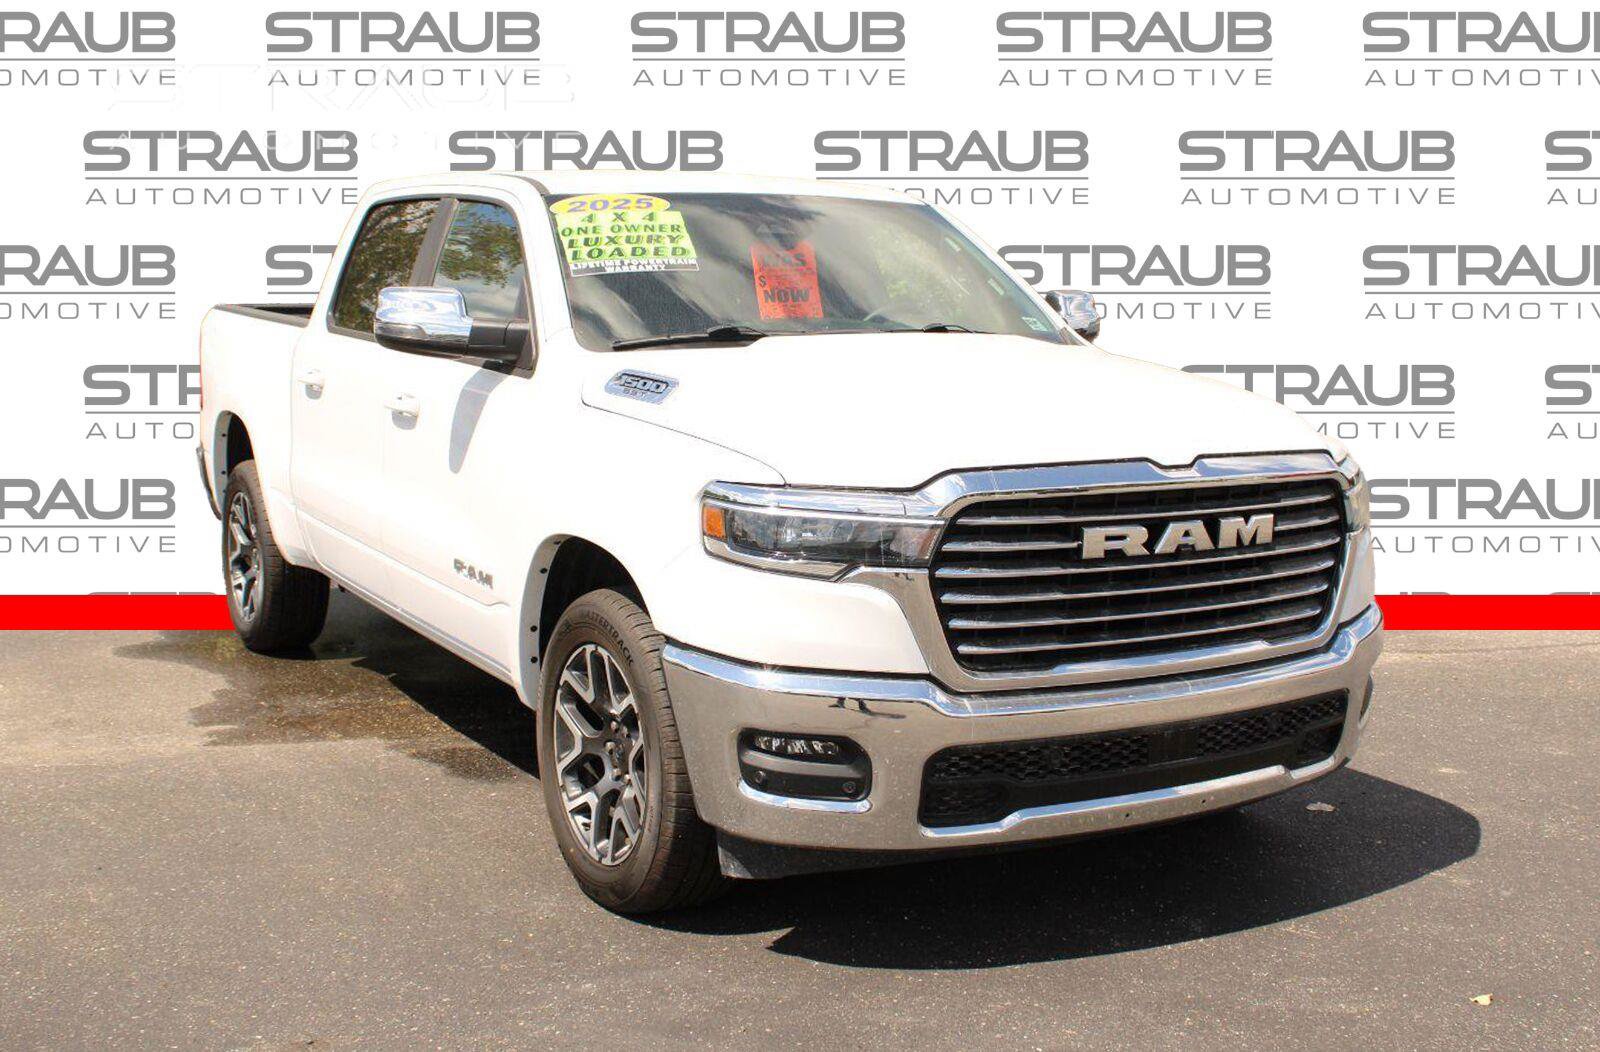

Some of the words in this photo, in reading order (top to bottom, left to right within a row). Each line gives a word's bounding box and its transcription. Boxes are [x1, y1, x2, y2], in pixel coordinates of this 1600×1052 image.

[266, 11, 541, 53] STRAUB
[631, 11, 906, 53] STRAUB
[997, 11, 1273, 53] STRAUB
[1363, 11, 1600, 53] STRAU
[267, 69, 540, 86] AUTOMOTIVE
[633, 69, 906, 86] AUTOMOTIVE
[998, 69, 1272, 86] AUTOMOTIVE
[83, 129, 358, 171] STRAUB
[449, 129, 724, 171] STRAUB
[814, 129, 1089, 171] STRAUB
[1179, 129, 1455, 171] STRAUB
[1545, 130, 1600, 171] S
[85, 188, 358, 205] AUTOMOTIVE
[567, 198, 654, 212] 2025
[1181, 188, 1455, 205] AUTOMOTIVE
[561, 225, 601, 237] ONE
[610, 224, 682, 234] OWNER
[568, 234, 684, 249] LUXURY
[265, 245, 338, 286] S
[571, 246, 692, 261] LOADED
[605, 264, 666, 273] WARRANTY
[1363, 245, 1600, 286] STRAU
[763, 287, 810, 304] NOW
[1181, 364, 1455, 406] TRAUB
[1545, 364, 1600, 406] S
[85, 422, 194, 439] AUTO
[1367, 478, 1600, 520] STRAU
[1082, 514, 1274, 559] RAM
[453, 557, 494, 590] RAM
